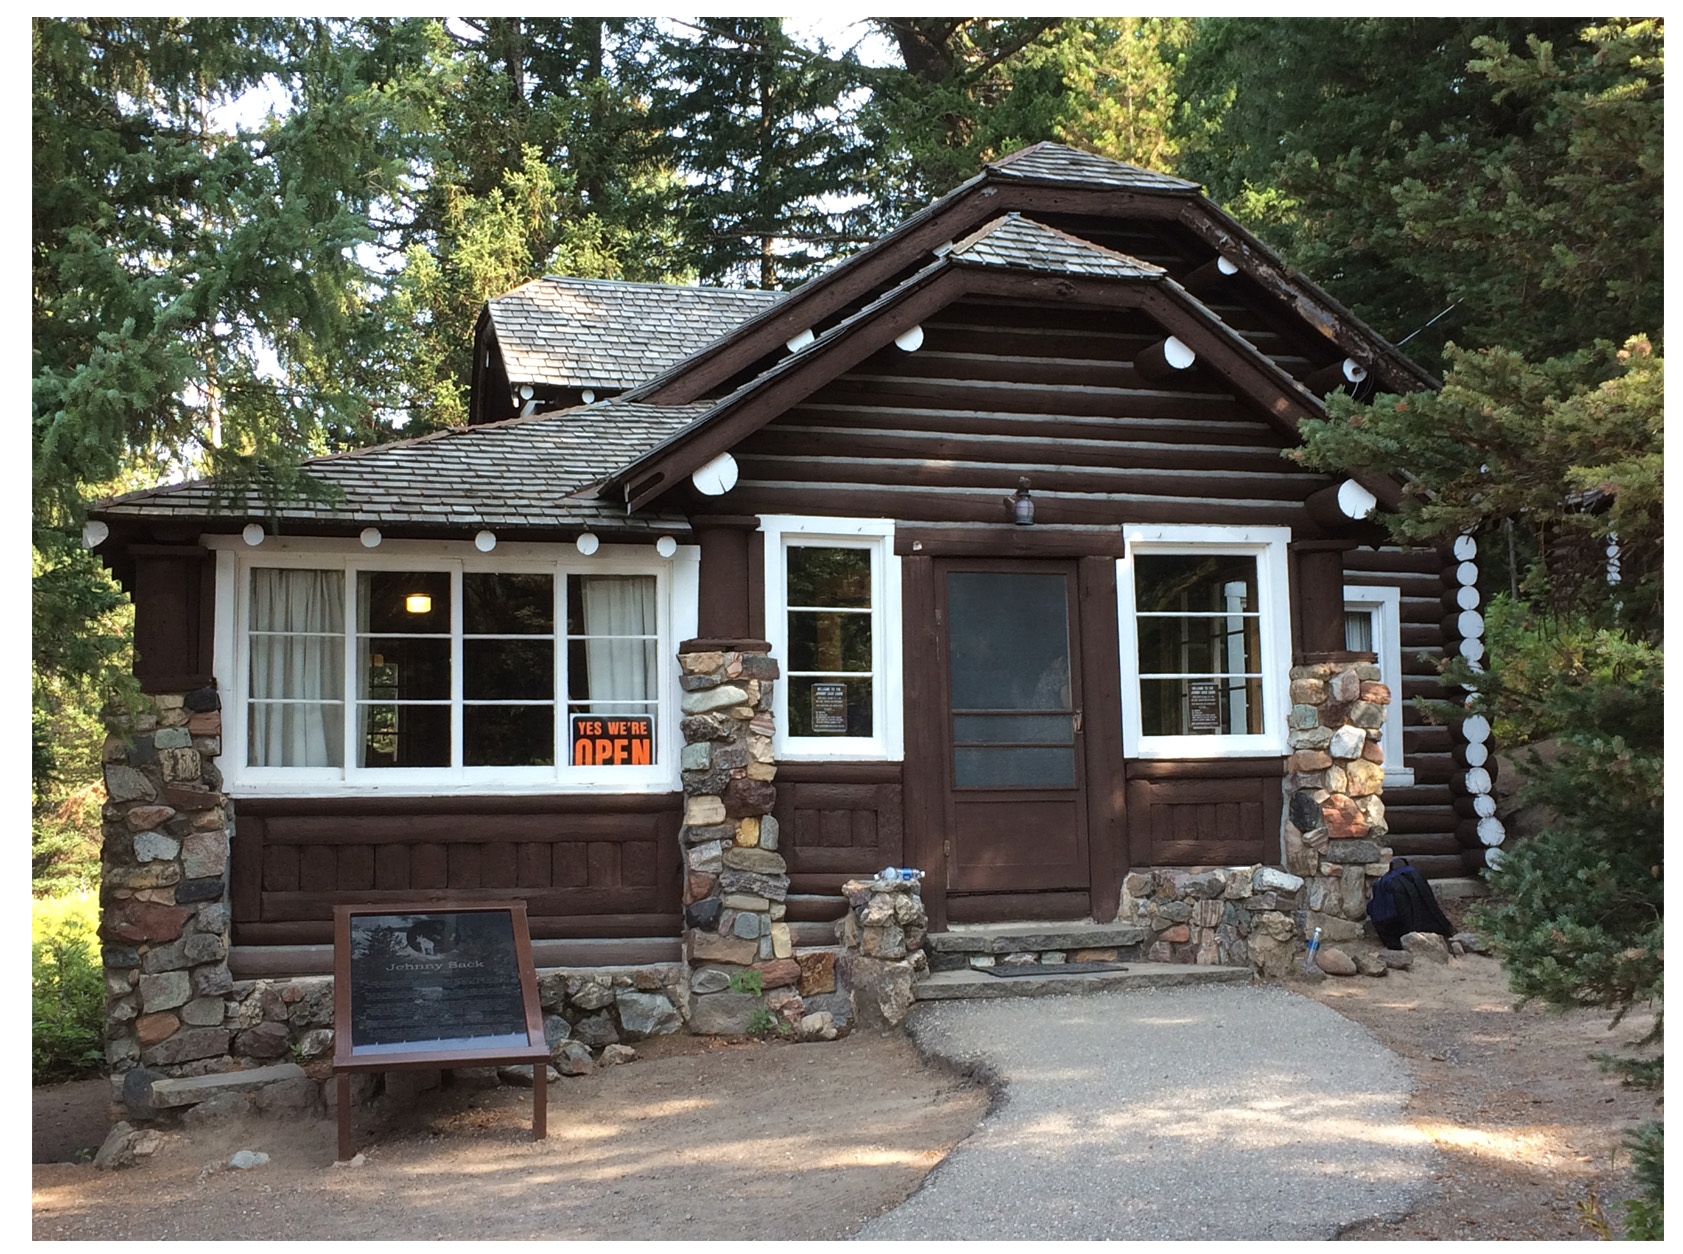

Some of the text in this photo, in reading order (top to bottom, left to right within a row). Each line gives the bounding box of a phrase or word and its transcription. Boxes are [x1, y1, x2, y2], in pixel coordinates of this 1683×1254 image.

[578, 721, 648, 735] YES WE'RE
[575, 738, 651, 766] OPEN
[385, 960, 485, 972] Johnny Sack
